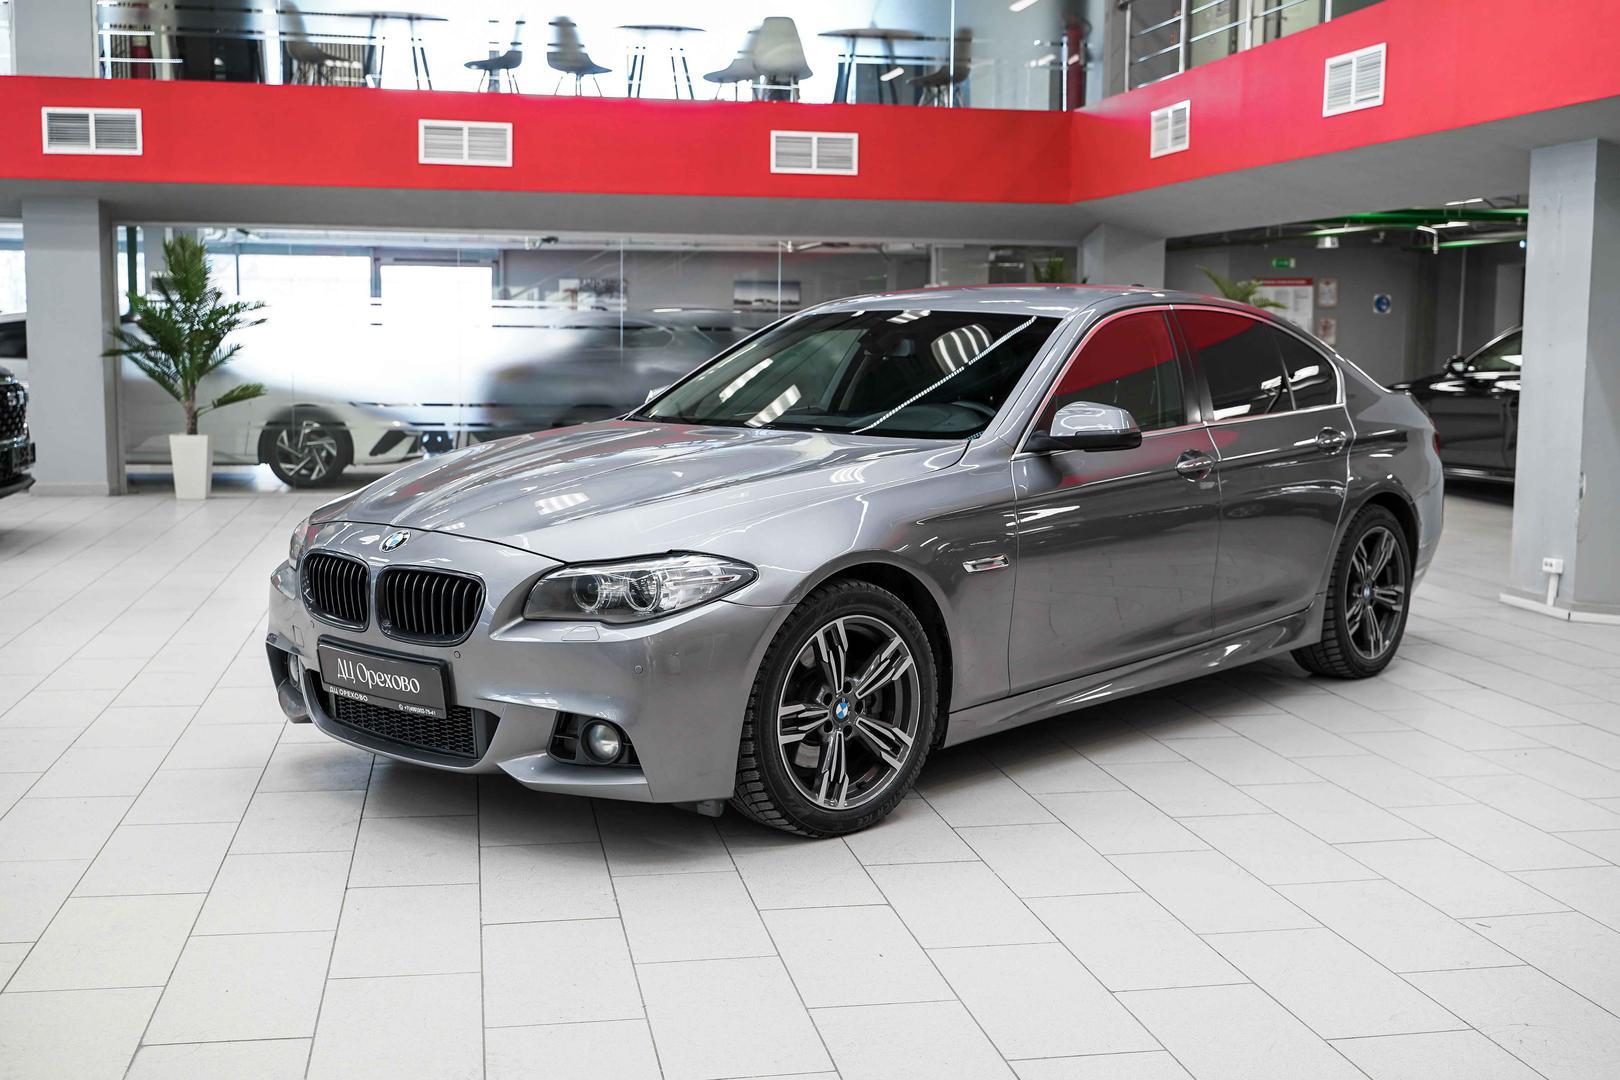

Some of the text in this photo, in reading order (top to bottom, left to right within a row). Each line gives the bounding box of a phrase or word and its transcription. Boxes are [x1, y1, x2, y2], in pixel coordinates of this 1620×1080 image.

[337, 657, 420, 694] ДЦ Орехово
[339, 688, 369, 702] ОРЕХОВО
